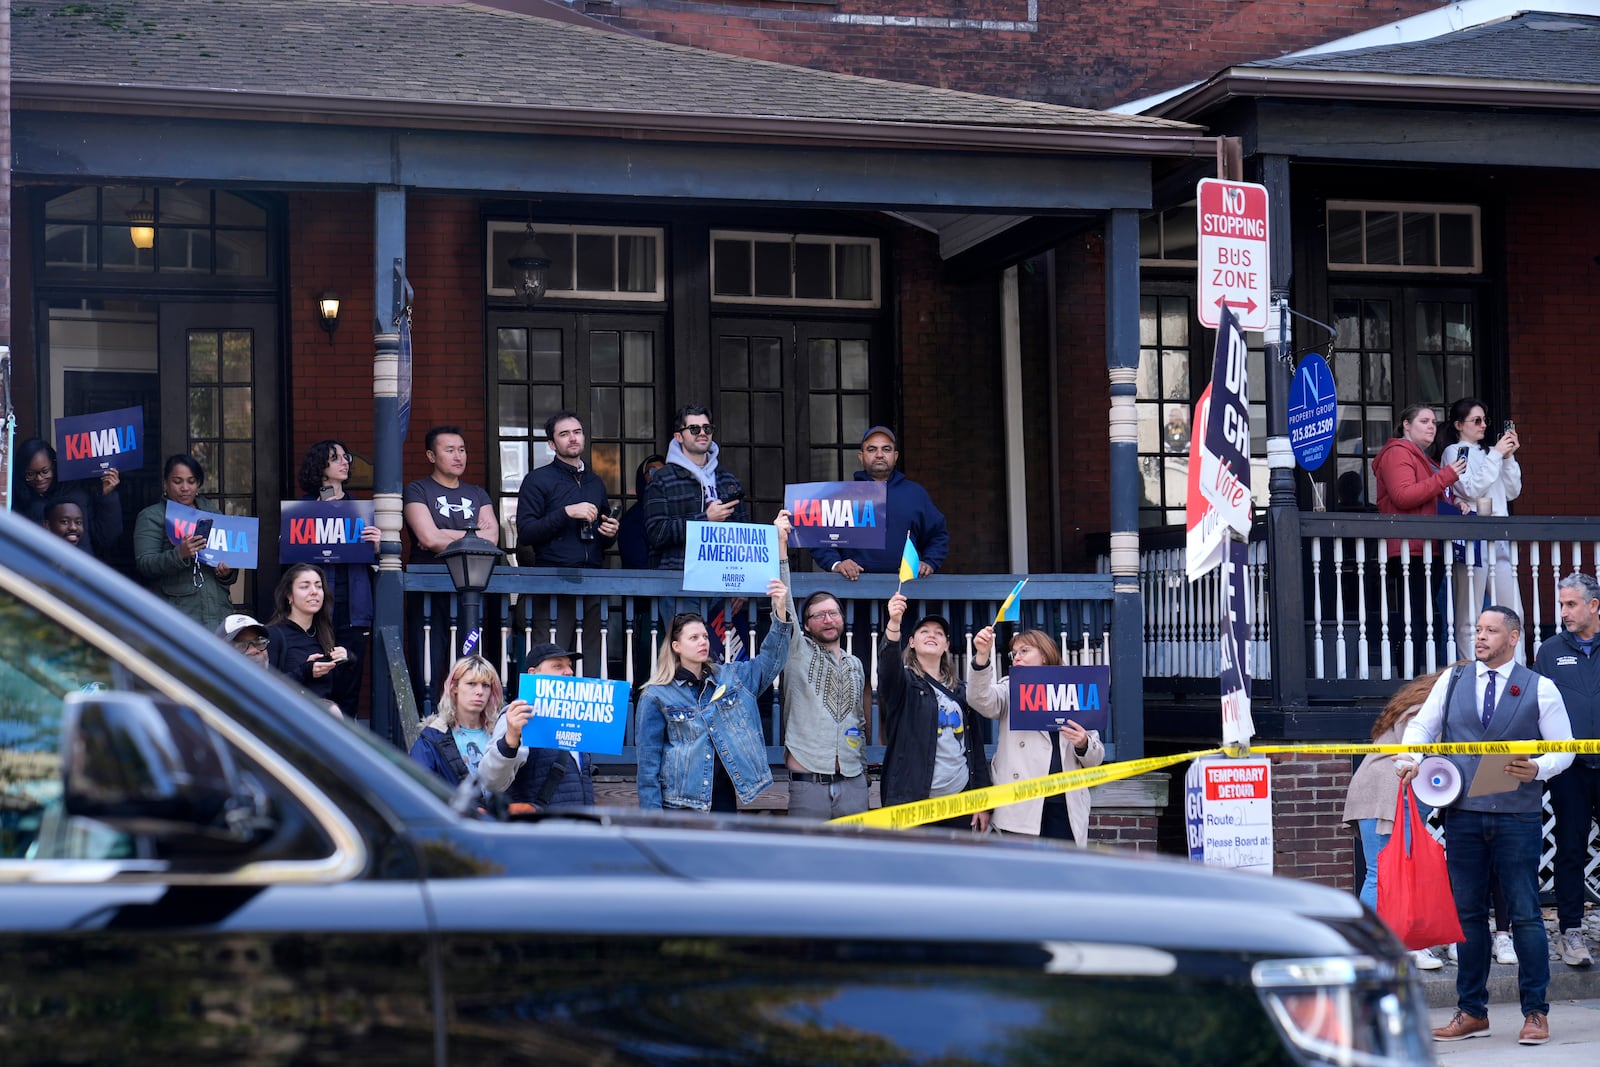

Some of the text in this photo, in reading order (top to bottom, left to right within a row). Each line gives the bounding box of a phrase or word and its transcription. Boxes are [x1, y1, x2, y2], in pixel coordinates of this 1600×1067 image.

[1222, 186, 1245, 215] NO
[1204, 214, 1264, 238] STOPPING
[1218, 247, 1251, 267] BUS
[1212, 269, 1258, 290] ZONE
[1302, 362, 1319, 410] N
[1289, 402, 1335, 425] PROPERTY GROUP
[1292, 417, 1334, 443] 215.825.2509
[65, 425, 137, 461] KAMALA
[1215, 455, 1244, 507] Vote
[794, 499, 876, 527] KAMALA
[290, 517, 365, 544] KAMALA
[701, 526, 767, 545] UKRAINIAN
[698, 544, 769, 563] AMERICANS
[722, 573, 745, 582] HARRIS
[535, 679, 614, 704] UKRAINIAN
[1020, 684, 1100, 711] KAMALA
[533, 698, 614, 723] AMERICANS
[555, 730, 582, 742] HARRIS
[1437, 745, 1453, 753] LINE
[1485, 743, 1511, 753] CROSS
[1537, 742, 1562, 752] POLICE
[1565, 742, 1581, 752] LINE
[1207, 768, 1265, 783] TEMPORARY
[1218, 784, 1255, 798] DETOUR
[1207, 814, 1234, 826] Route
[1234, 806, 1247, 826] 21
[1207, 836, 1271, 848] Please Board at:
